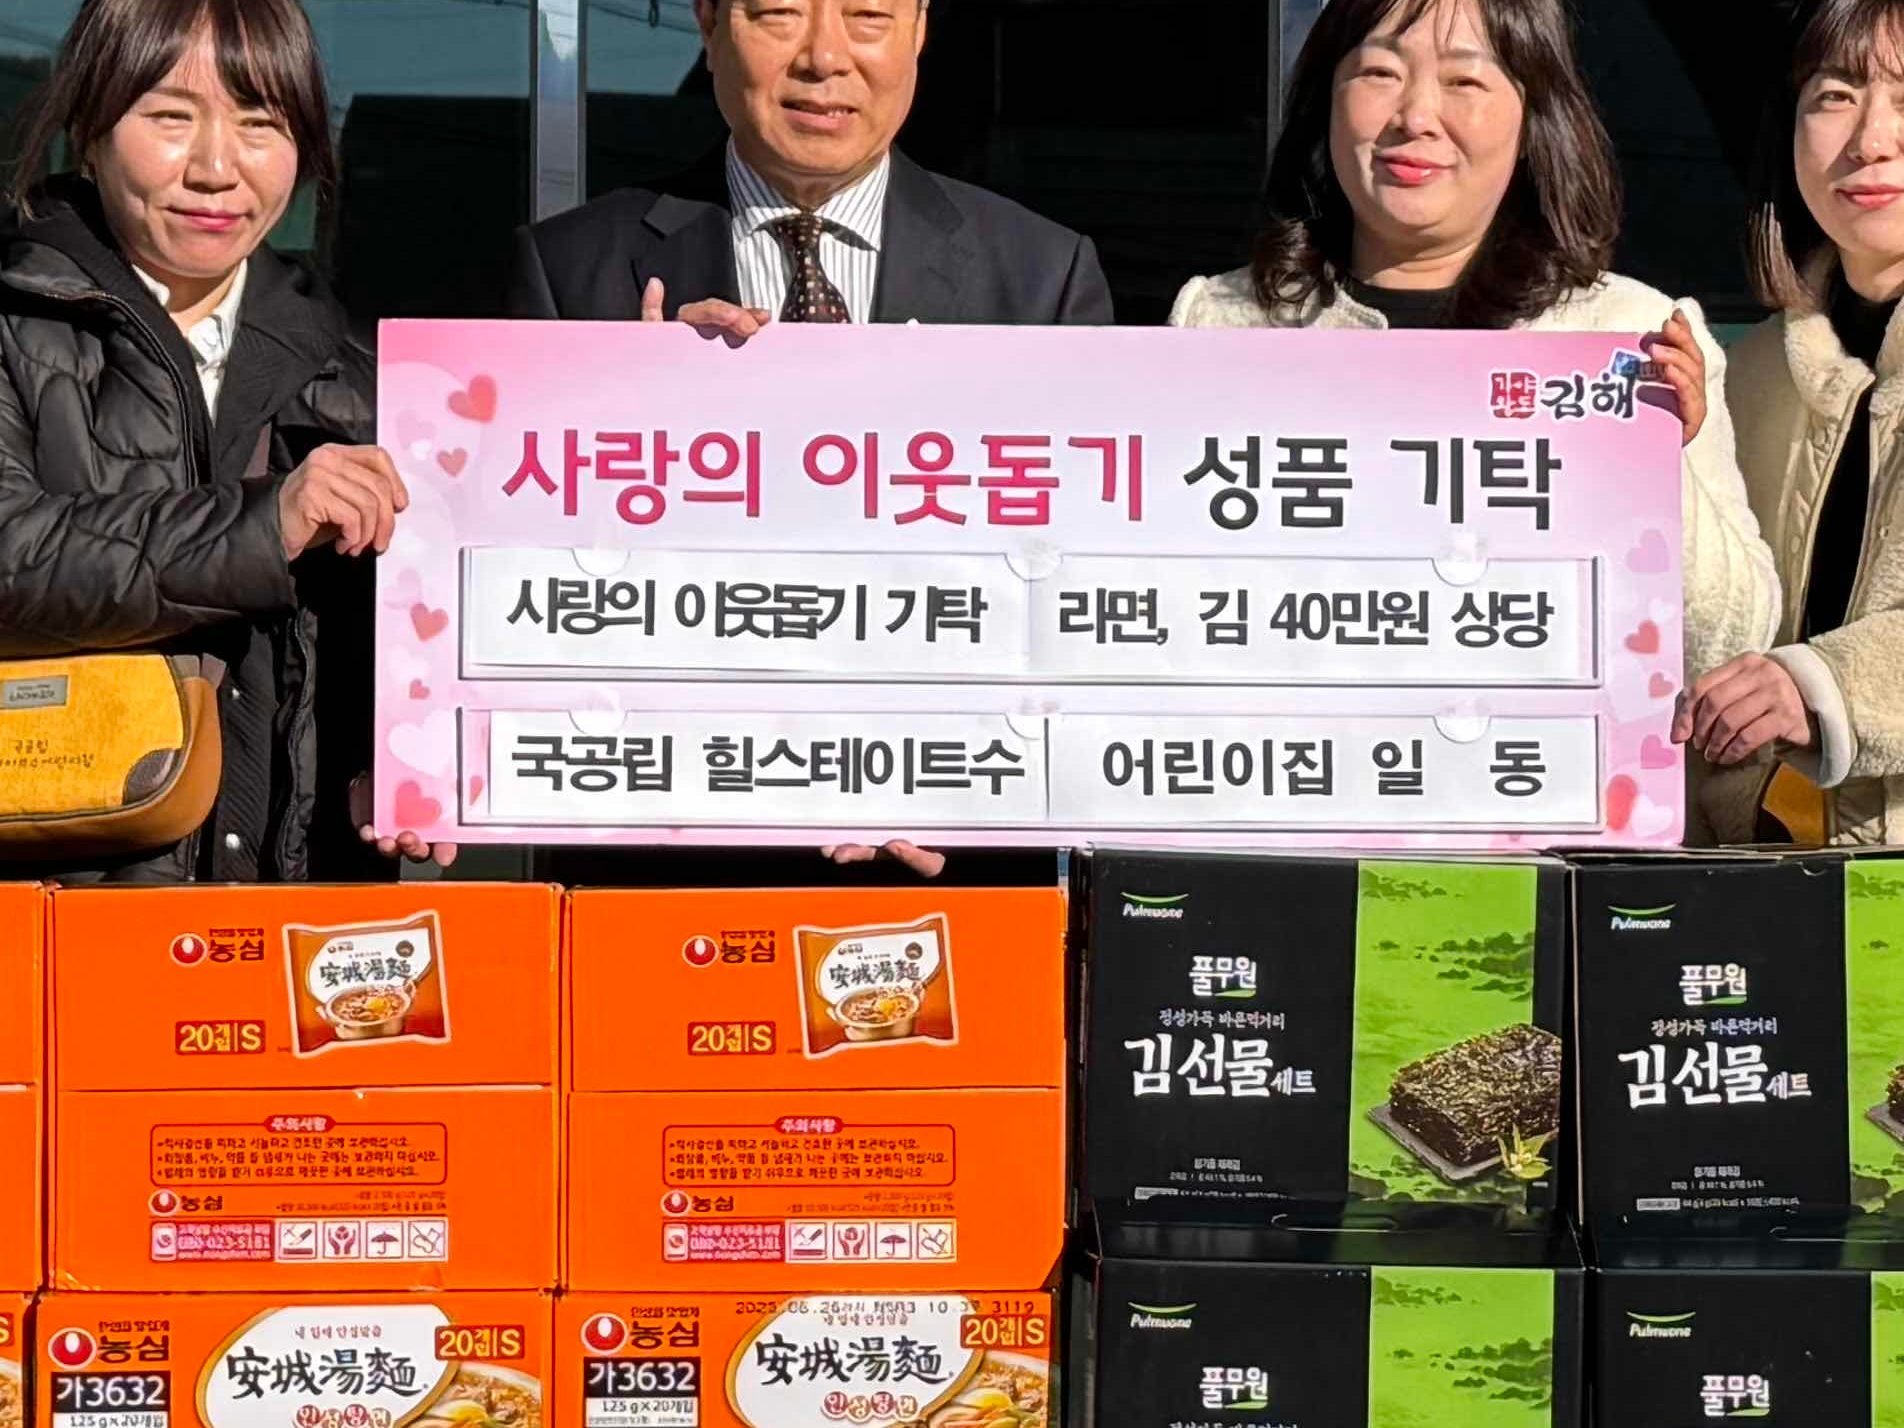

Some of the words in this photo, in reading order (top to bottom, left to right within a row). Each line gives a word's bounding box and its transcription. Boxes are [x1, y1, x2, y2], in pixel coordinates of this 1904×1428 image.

[1541, 373, 1634, 419] 김해
[502, 429, 761, 525] 사랑의
[803, 431, 1141, 526] 이웃돕기
[1184, 435, 1353, 530] 성품
[1391, 437, 1562, 530] 기탁
[507, 577, 655, 635] 사랑의
[675, 580, 867, 640] 이웃돕기
[886, 584, 988, 643] 기탁
[1059, 587, 1169, 646] 라면,
[1199, 589, 1249, 645] 김
[1270, 590, 1429, 646] 40만원
[1451, 590, 1554, 648] 상당
[511, 735, 672, 792] 국공립
[703, 736, 1025, 795] 힐스테이트수
[1103, 738, 1333, 796] 어린이집
[1372, 740, 1423, 796] 일
[1490, 740, 1546, 796] 동
[208, 940, 265, 962] 농심
[721, 942, 776, 963] 농심
[1189, 956, 1257, 997] 풀무원
[1679, 964, 1747, 1004] 풀무원
[97, 1336, 170, 1362] 농심
[629, 1321, 700, 1348] 농심
[227, 1347, 421, 1400] 安城湯麵
[587, 1361, 696, 1392] 가3632
[756, 1333, 948, 1386] 安城湯麵
[55, 1377, 166, 1407] 가3632
[1199, 1367, 1269, 1409] 풀무원
[1700, 1375, 1770, 1416] 풀무원
